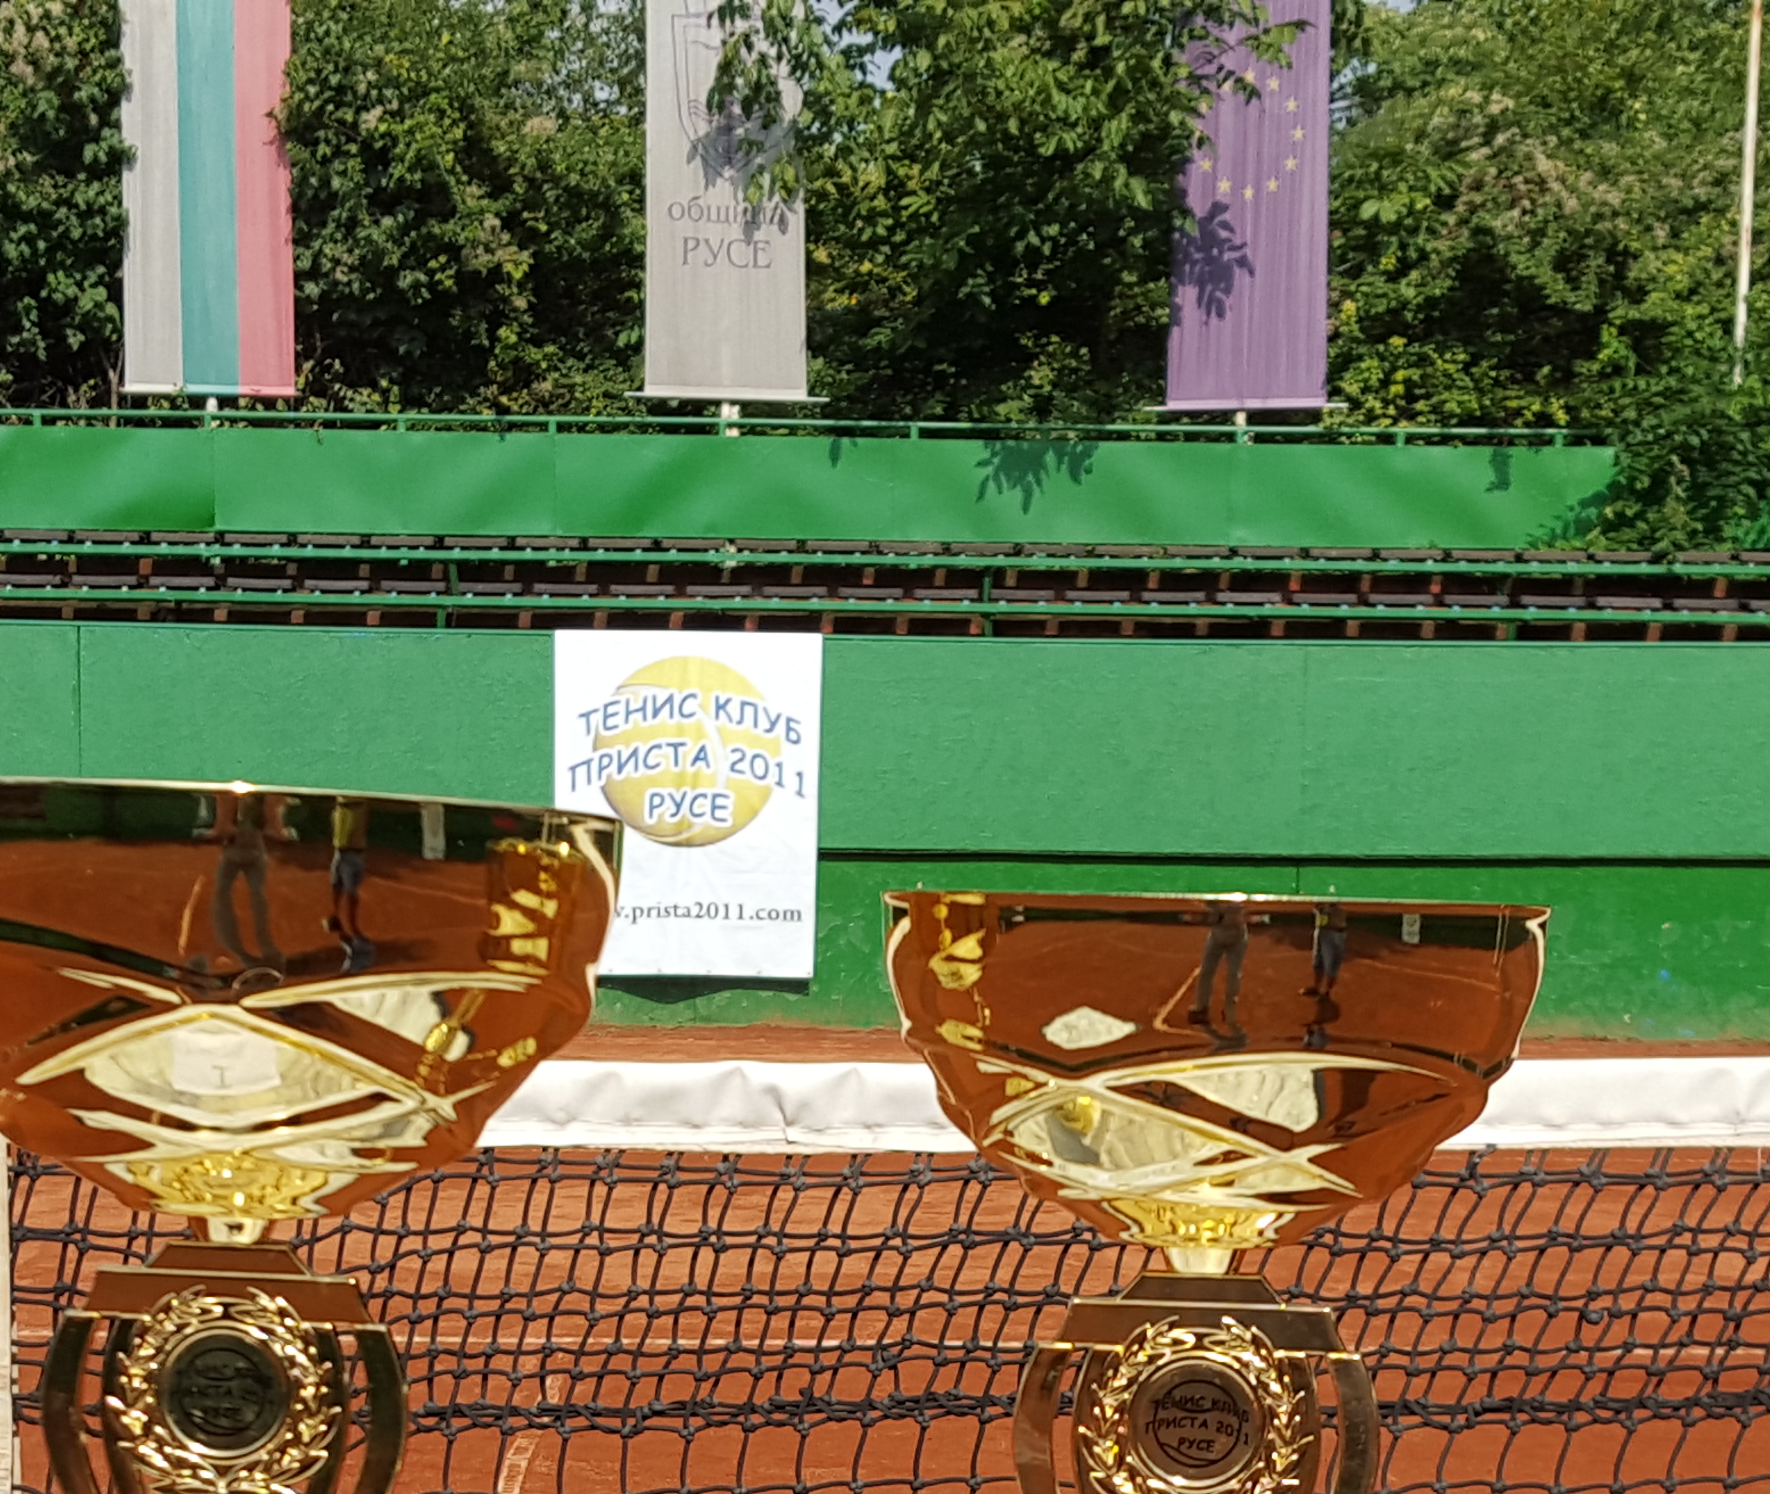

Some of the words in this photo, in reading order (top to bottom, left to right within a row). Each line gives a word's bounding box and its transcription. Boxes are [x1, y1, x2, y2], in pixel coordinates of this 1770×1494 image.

[682, 236, 773, 269] РУСЕ
[578, 693, 698, 737] ТЕНИС
[714, 695, 802, 745] КЛУБ
[567, 743, 711, 792] ПРИСТА
[730, 748, 806, 799] 2011
[648, 792, 730, 823] РУСЕ
